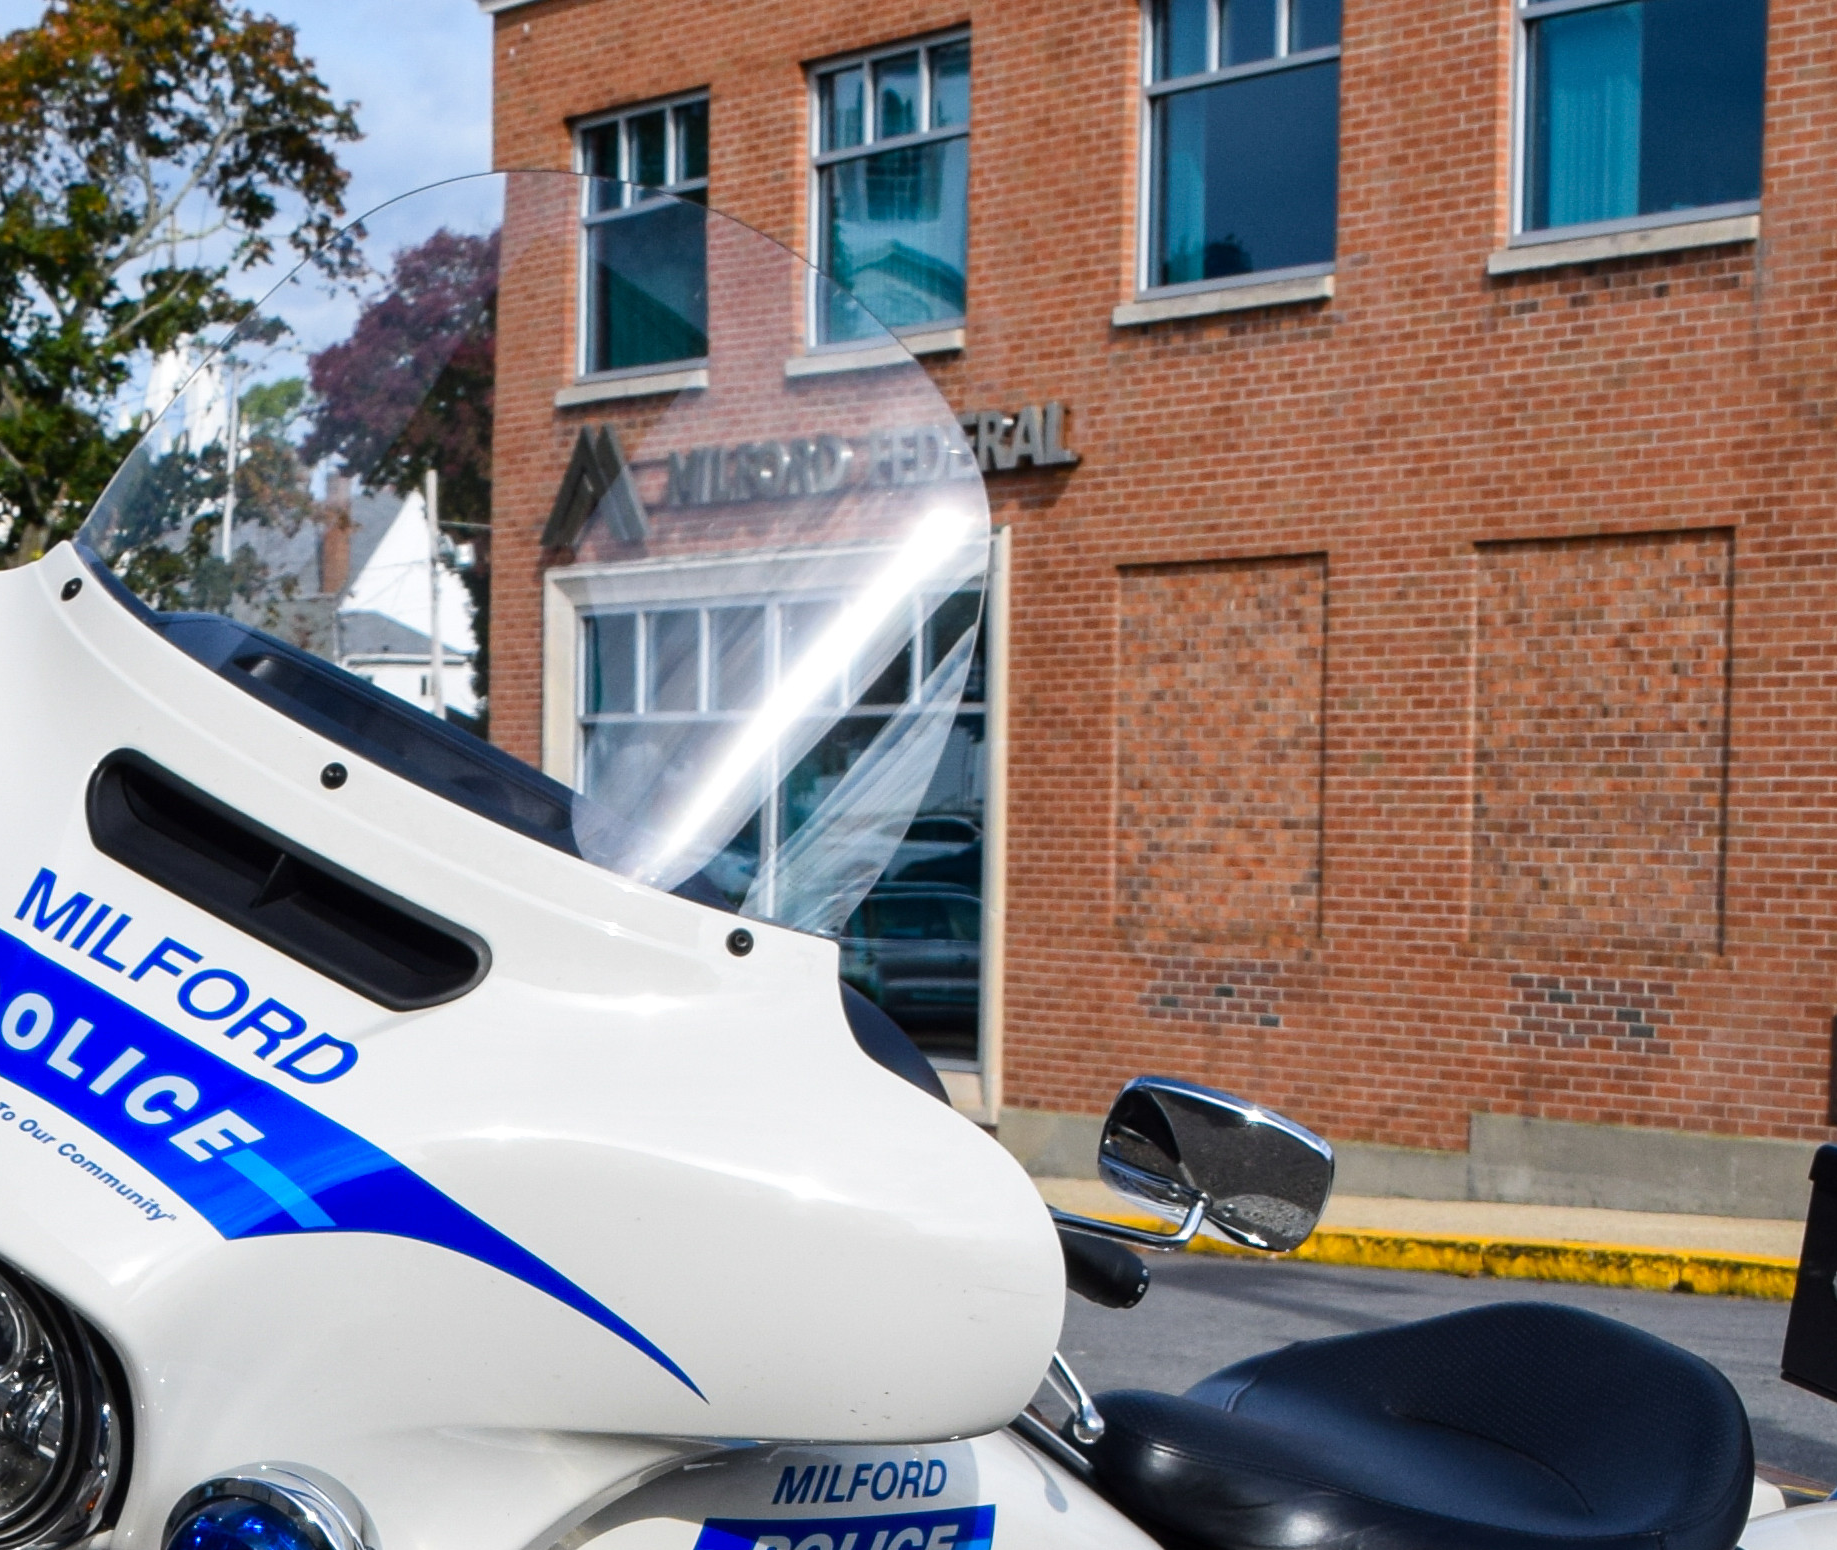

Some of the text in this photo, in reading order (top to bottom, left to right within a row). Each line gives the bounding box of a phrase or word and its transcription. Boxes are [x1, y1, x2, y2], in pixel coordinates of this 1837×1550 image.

[669, 401, 1079, 505] MILFORD FEDERAL
[15, 867, 359, 1084] MILFORD
[18, 1118, 58, 1145] Our
[57, 1142, 177, 1222] Community"
[771, 1459, 948, 1505] MILFORD
